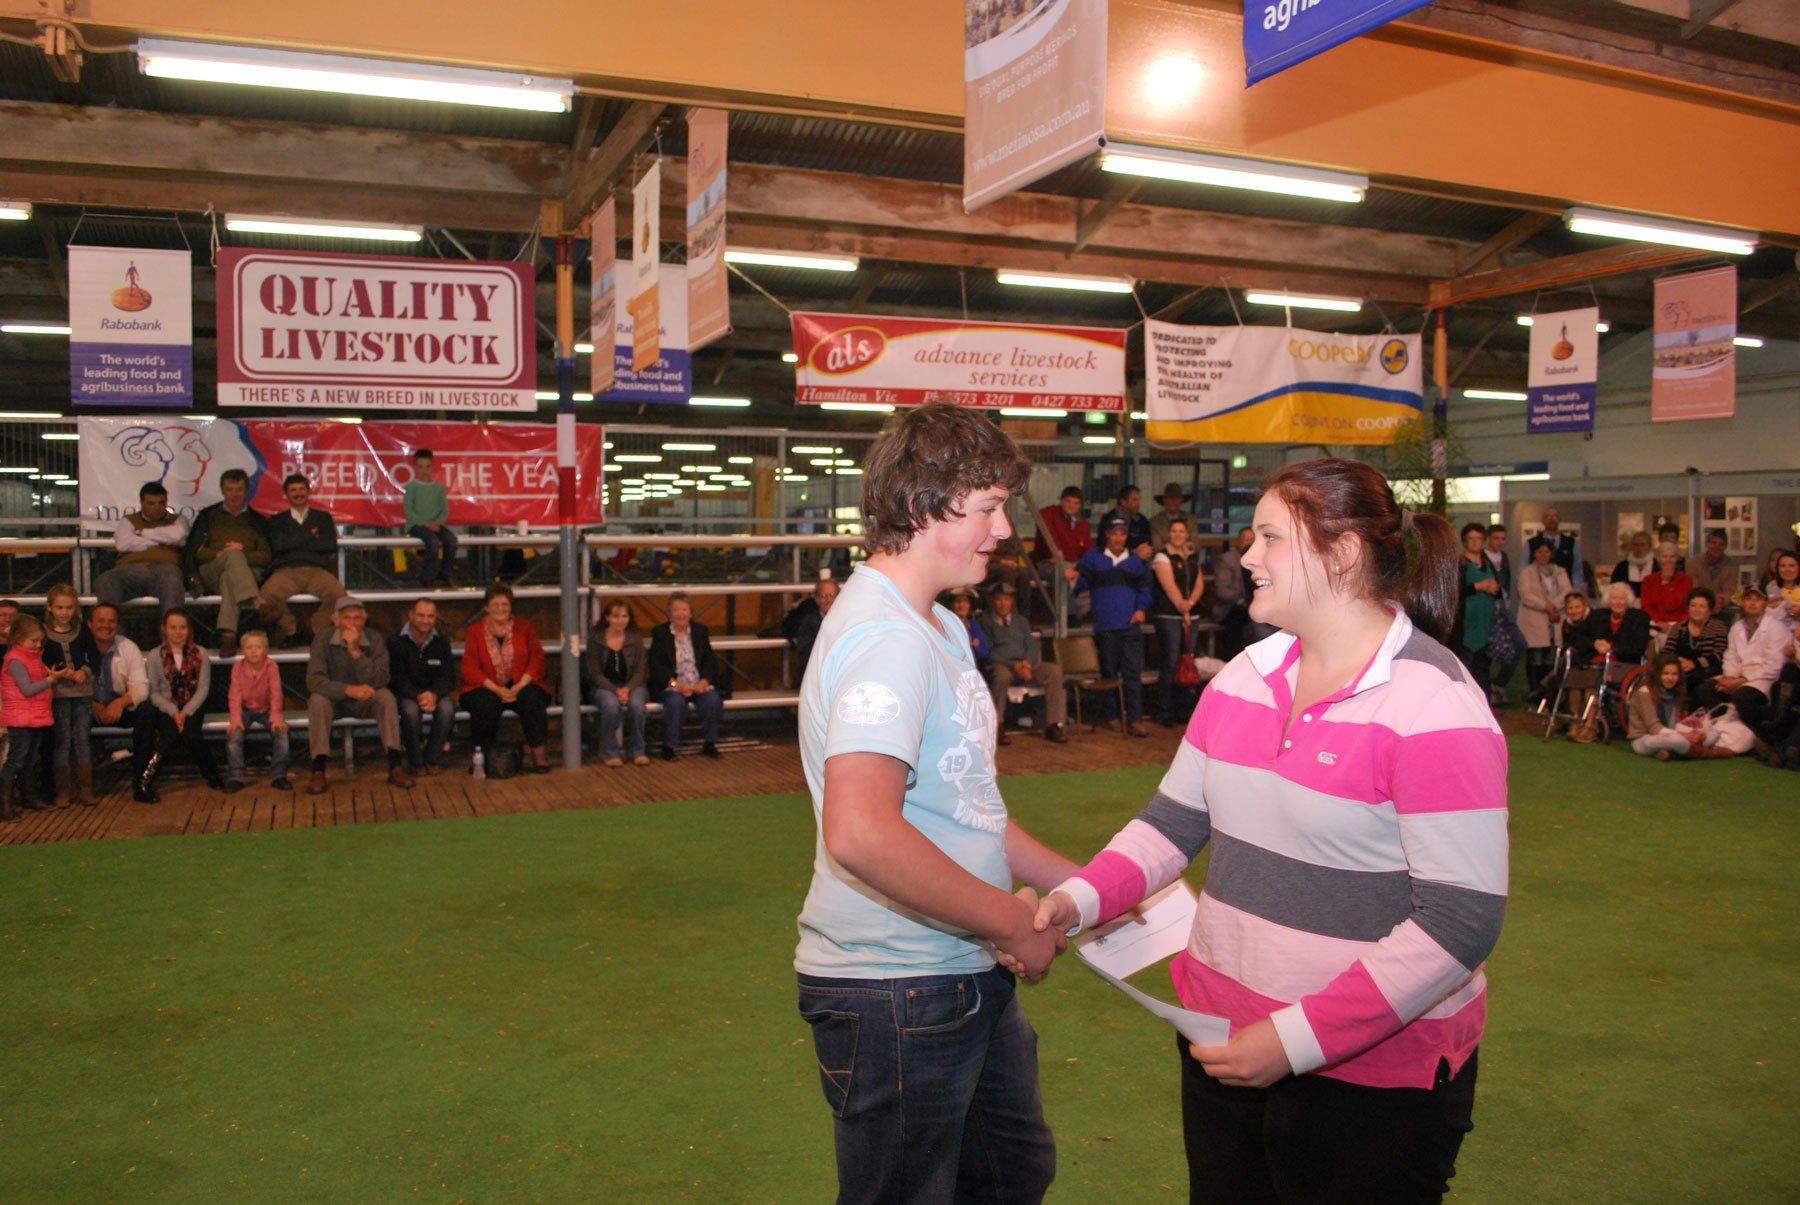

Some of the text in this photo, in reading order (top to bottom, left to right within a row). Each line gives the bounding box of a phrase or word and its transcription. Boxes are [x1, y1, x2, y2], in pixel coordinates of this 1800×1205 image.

[1032, 55, 1060, 82] PROFIT
[972, 100, 1090, 173] www.merinosa.com.au
[260, 273, 499, 322] QUALITY
[101, 318, 162, 331] Rabobank
[260, 327, 500, 365] LIVESTOCK
[827, 332, 871, 371] als
[1287, 338, 1376, 364] COOPERS
[100, 354, 166, 366] The world's
[615, 355, 632, 365] The
[914, 344, 1097, 370] advance livestock
[1174, 358, 1232, 369] IMPROVING
[84, 367, 182, 381] leading food and
[614, 367, 682, 381] ding food and
[969, 368, 1048, 387] services
[1170, 369, 1206, 380] HEALTH
[1210, 372, 1223, 380] OF
[81, 381, 185, 397] agribusiness bank
[660, 383, 684, 393] bank
[1158, 378, 1211, 391] ATRALIAN
[239, 387, 519, 407] THERE'S A NEW BREED IN LIVESTOCK
[802, 388, 868, 402] Hamilton
[875, 390, 898, 403] Vic
[982, 393, 1015, 406] 3201
[1032, 395, 1066, 408] 0427
[1070, 396, 1093, 409] 733
[1097, 397, 1120, 409] 201
[1158, 390, 1200, 403] LIVOCK
[282, 461, 379, 488] BREED
[441, 462, 492, 488] THE
[502, 463, 579, 488] YEA
[944, 755, 966, 773] 19
